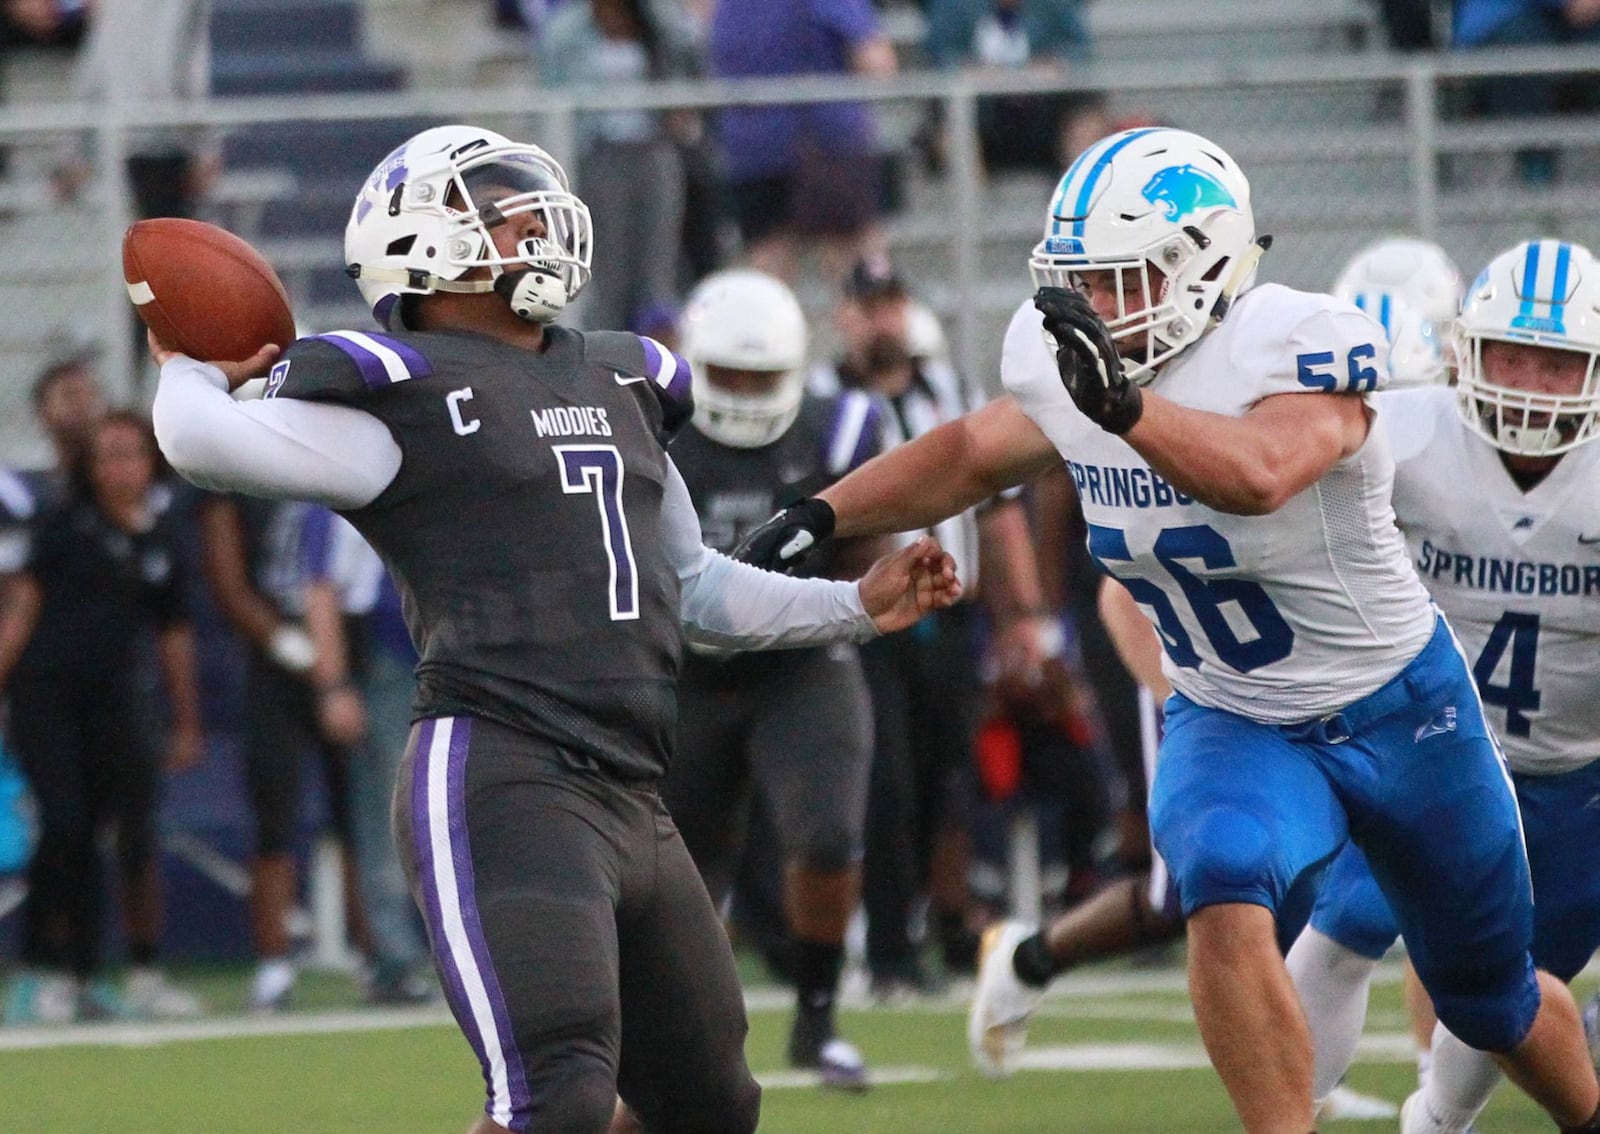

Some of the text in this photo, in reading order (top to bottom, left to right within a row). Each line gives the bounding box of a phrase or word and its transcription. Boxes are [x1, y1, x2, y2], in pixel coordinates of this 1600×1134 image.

[263, 360, 291, 400] 7
[1297, 343, 1378, 393] 56
[445, 386, 481, 436] C
[530, 406, 613, 438] MIDDIES
[551, 444, 640, 621] 7
[1087, 523, 1295, 674] 56
[1473, 610, 1542, 738] 4
